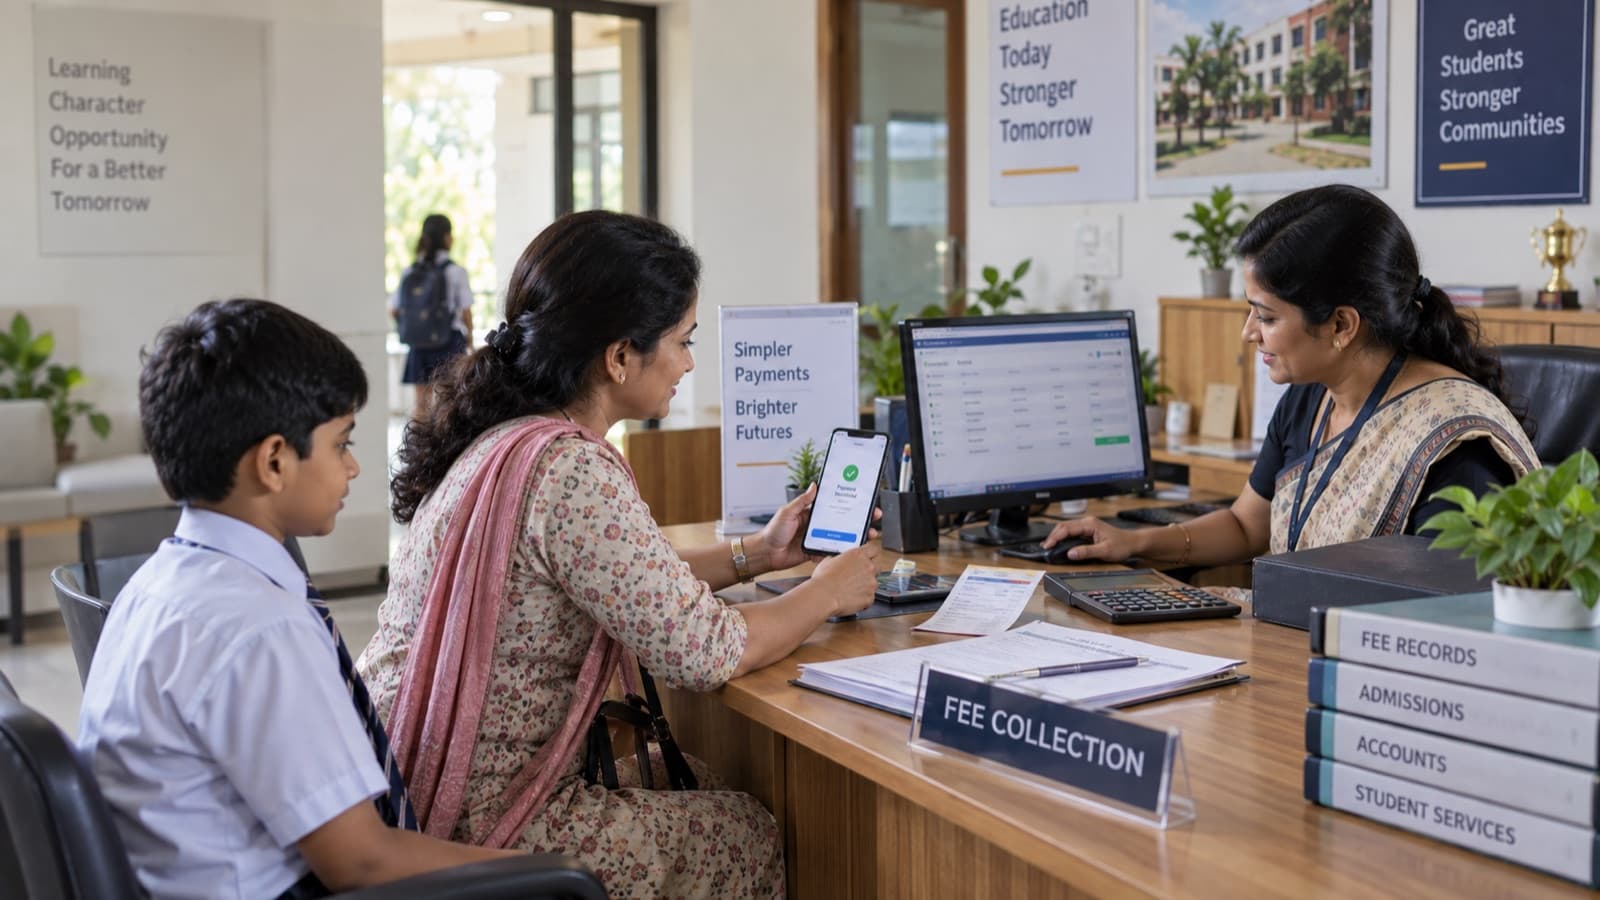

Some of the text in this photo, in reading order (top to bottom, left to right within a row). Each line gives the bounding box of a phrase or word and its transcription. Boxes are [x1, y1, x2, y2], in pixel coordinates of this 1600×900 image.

[1000, 0, 1088, 32] Education
[1464, 14, 1515, 41] Great
[1000, 41, 1051, 69] Today
[1441, 48, 1523, 77] Students
[49, 58, 131, 86] Learning
[49, 91, 144, 114] Character
[1000, 80, 1077, 108] Stronger
[1440, 82, 1521, 112] Stronger
[50, 125, 167, 154] Opportunity
[1000, 117, 1093, 142] Tomorrow
[1440, 115, 1566, 143] Communities
[51, 158, 166, 180] For a Better
[51, 191, 150, 211] Tomorrow
[735, 341, 792, 360] Simpler
[736, 367, 809, 386] Payments
[736, 400, 797, 419] Brighter
[736, 425, 792, 440] Futures
[1362, 631, 1476, 667] FEE RECORDS
[1359, 684, 1465, 721] ADMISSIONS
[945, 696, 1144, 776] FEE COLLECTION
[1356, 735, 1447, 773] ACCOUNTS
[1355, 784, 1516, 845] STUDENT SERVICES
